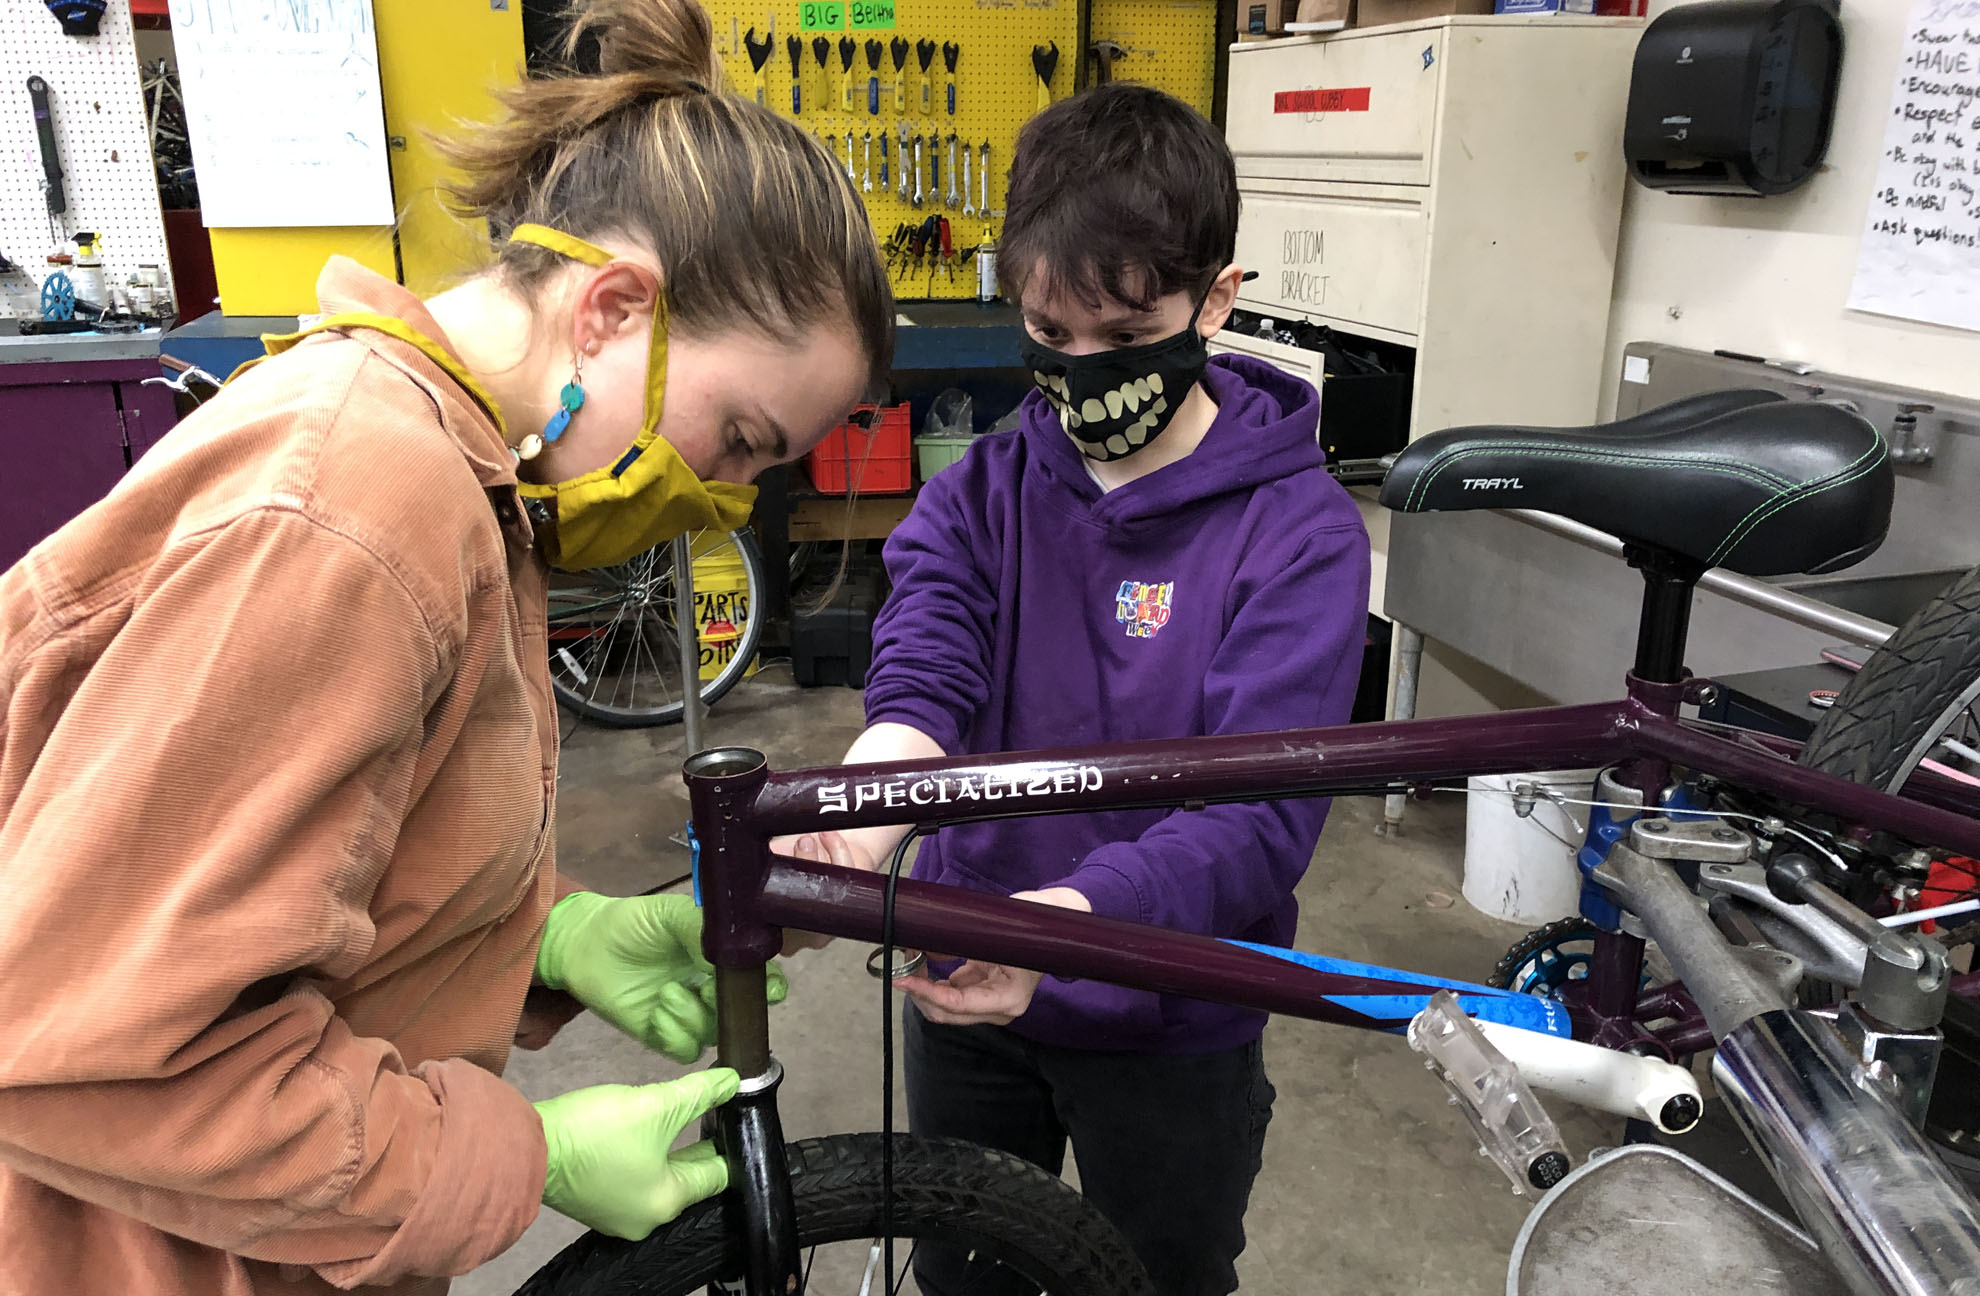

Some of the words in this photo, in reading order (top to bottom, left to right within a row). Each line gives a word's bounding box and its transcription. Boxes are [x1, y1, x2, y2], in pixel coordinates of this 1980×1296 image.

[805, 4, 839, 27] BIG
[1914, 49, 1972, 74] HAVE
[1904, 102, 1963, 131] Respect
[1885, 187, 1899, 207] Be
[1881, 216, 1907, 236] Ask
[1283, 229, 1324, 265] BOTTOM
[1281, 270, 1331, 306] BRACKET
[1462, 478, 1524, 490] TRAYL
[693, 591, 748, 625] PARTS
[818, 765, 1103, 815] SPECIALIZED
